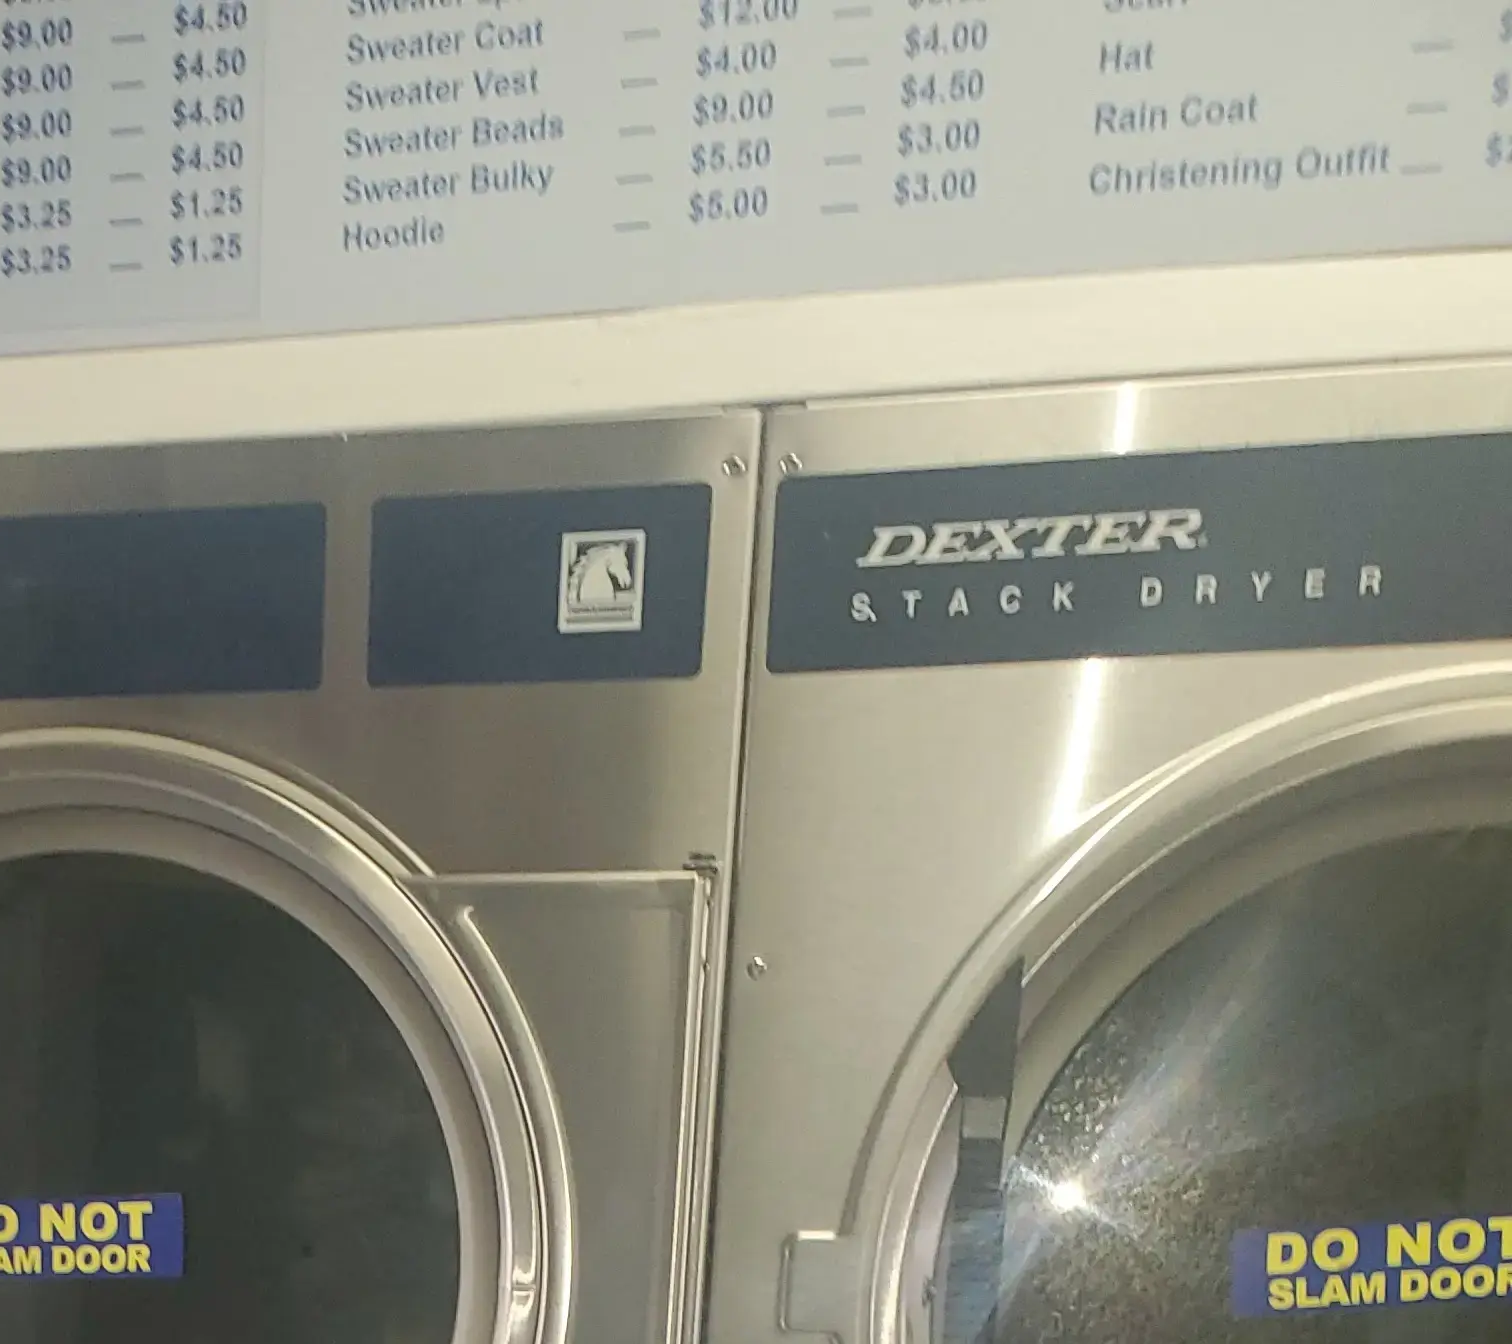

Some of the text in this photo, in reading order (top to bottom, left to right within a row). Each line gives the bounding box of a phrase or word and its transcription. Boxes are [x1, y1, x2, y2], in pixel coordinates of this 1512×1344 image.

[1, 16, 74, 54] $9.00
[346, 18, 545, 66] Sweater Coat
[1099, 40, 1155, 74] Hat
[1, 46, 247, 98] $9.00 $4.50
[344, 66, 540, 113] Sweater Vest
[1, 93, 246, 145] $9.00 $4.50
[343, 111, 565, 159] Sweater Beads
[1093, 94, 1258, 136] Rain Coat
[342, 160, 556, 206] Sweater Bulky
[1089, 142, 1392, 196] Christening Outfit
[341, 217, 445, 253] Hoodie
[854, 508, 1203, 568] DEXTER
[850, 564, 1384, 624] STACK DRYER
[39, 1200, 153, 1242] NOT
[51, 1243, 152, 1275] DOOR
[1265, 1227, 1360, 1276] DO
[1267, 1271, 1387, 1311] SLAM
